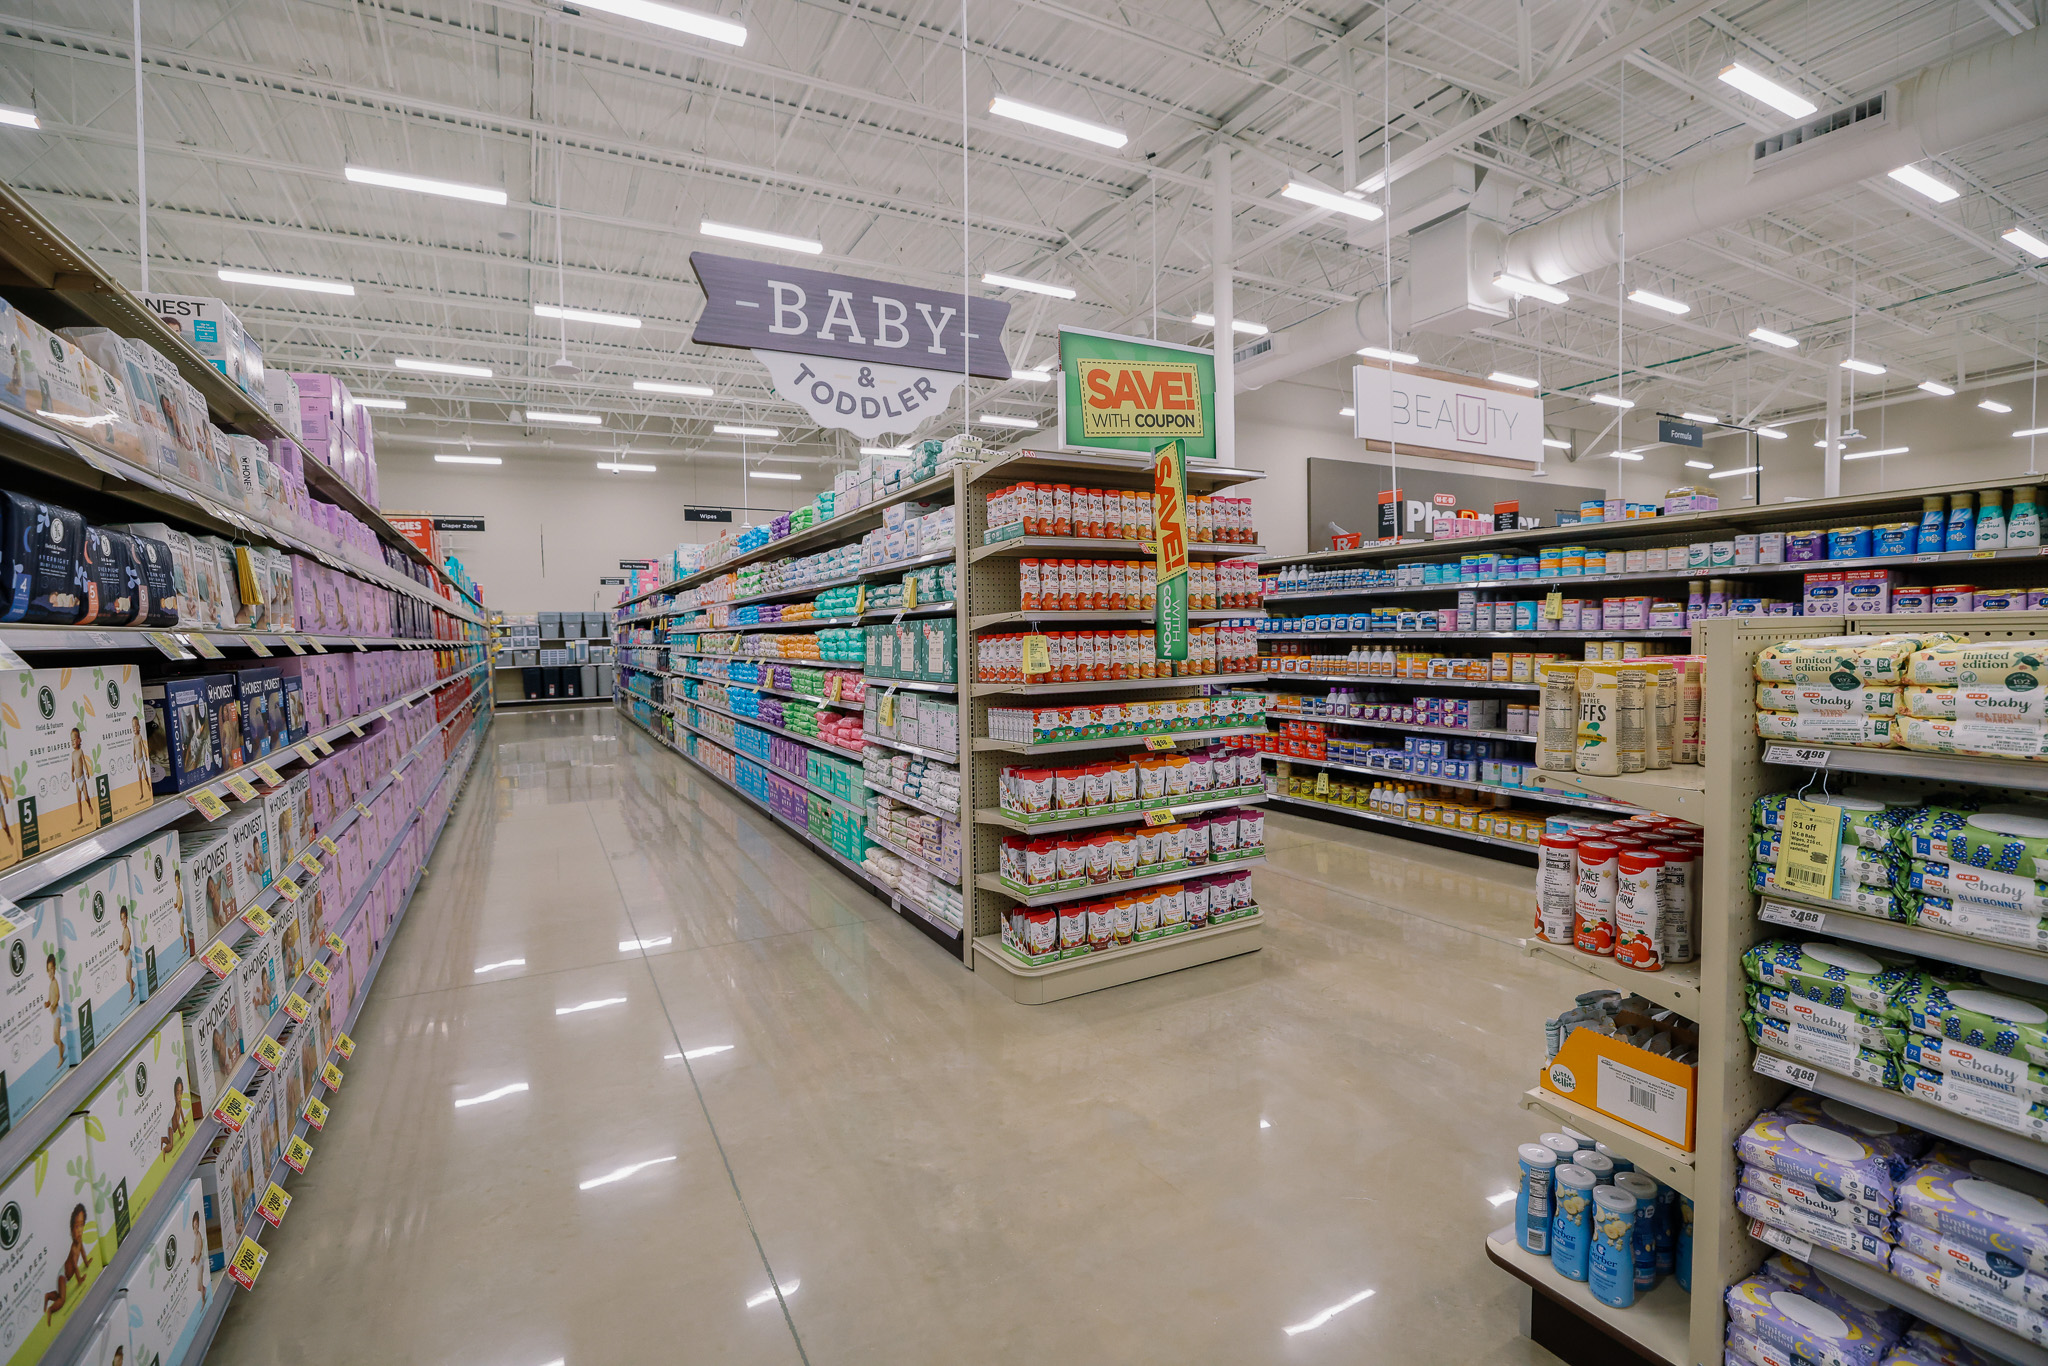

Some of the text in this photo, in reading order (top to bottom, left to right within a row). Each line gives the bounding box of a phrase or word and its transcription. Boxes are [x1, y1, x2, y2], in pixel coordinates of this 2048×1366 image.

[138, 297, 206, 317] NEST
[767, 280, 957, 355] BABY
[857, 366, 875, 388] &
[793, 362, 937, 419] TODDLER
[1087, 368, 1195, 410] SAVE!
[1091, 413, 1195, 428] WITH COUPON
[1393, 390, 1518, 440] BEAUTY
[1671, 429, 1693, 440] Formula
[1155, 455, 1186, 573] SAVE!
[441, 522, 461, 530] Diaper
[19, 577, 27, 593] 4
[89, 586, 96, 599] 5
[140, 590, 146, 602] 6
[1163, 585, 1172, 657] COUPON
[1172, 599, 1181, 642] WITH
[1795, 655, 1832, 664] limited
[1878, 659, 1888, 668] 64
[1962, 652, 2010, 660] limited
[1962, 660, 2009, 669] edition
[1795, 663, 1832, 672] edition
[213, 683, 233, 700] HONEST
[244, 680, 262, 697] HONEST
[1881, 694, 1890, 702] 64
[1820, 696, 1854, 710] baby
[1988, 697, 2032, 714] baby
[102, 727, 132, 741] BABY DIAPERS
[1876, 721, 1887, 729] 64
[29, 741, 71, 757] BABY DIAPERS
[100, 778, 107, 797] 5
[273, 790, 290, 811] HONEST
[23, 800, 33, 824] 5
[238, 814, 264, 845] HONEST
[1792, 821, 1817, 832] $1 off
[1789, 845, 1809, 853] varieties
[199, 841, 229, 877] HONEST
[1580, 868, 1600, 882] ONCE
[1579, 883, 1597, 898] FARM
[1980, 880, 2026, 901] baby
[1578, 899, 1596, 908] Organic
[1957, 893, 2023, 910] BLUEBONNET
[276, 904, 296, 932] HONEST
[1617, 910, 1633, 919] Organic
[1789, 909, 1819, 923] $488
[85, 938, 119, 968] BABY DIAPERS
[147, 950, 153, 969] 7
[248, 943, 271, 980] HONEST
[17, 994, 44, 1018] DIAPERS
[205, 985, 233, 1032] HONEST
[1761, 996, 1768, 1004] 72
[81, 1004, 88, 1027] 7
[1812, 1013, 1849, 1034] baby
[1914, 1016, 1922, 1024] 72
[1796, 1022, 1848, 1041] BLUEBONNET
[1554, 1069, 1573, 1082] Little
[1785, 1064, 1815, 1082] $488
[1972, 1058, 2019, 1084] baby
[1552, 1074, 1576, 1090] Bellies
[1906, 1077, 1913, 1085] 72
[1950, 1069, 2016, 1093] BLUEBONNET
[255, 1081, 273, 1120] HONEST
[129, 1101, 163, 1148] BABY DIAPERS
[225, 1127, 247, 1172] HONEST
[1776, 1157, 1813, 1176] limited
[116, 1186, 125, 1212] 3
[1865, 1187, 1876, 1197] 64
[1805, 1197, 1839, 1218] baby
[1868, 1213, 1879, 1222] 64
[1941, 1213, 1987, 1236] limited
[1863, 1238, 1874, 1248] 64
[1942, 1223, 1988, 1245] edition
[239, 1247, 256, 1272] $2997
[12, 1246, 48, 1293] DIAPERS
[1969, 1261, 2012, 1290] baby
[1758, 1319, 1794, 1344] limited
[1759, 1327, 1794, 1350] edition
